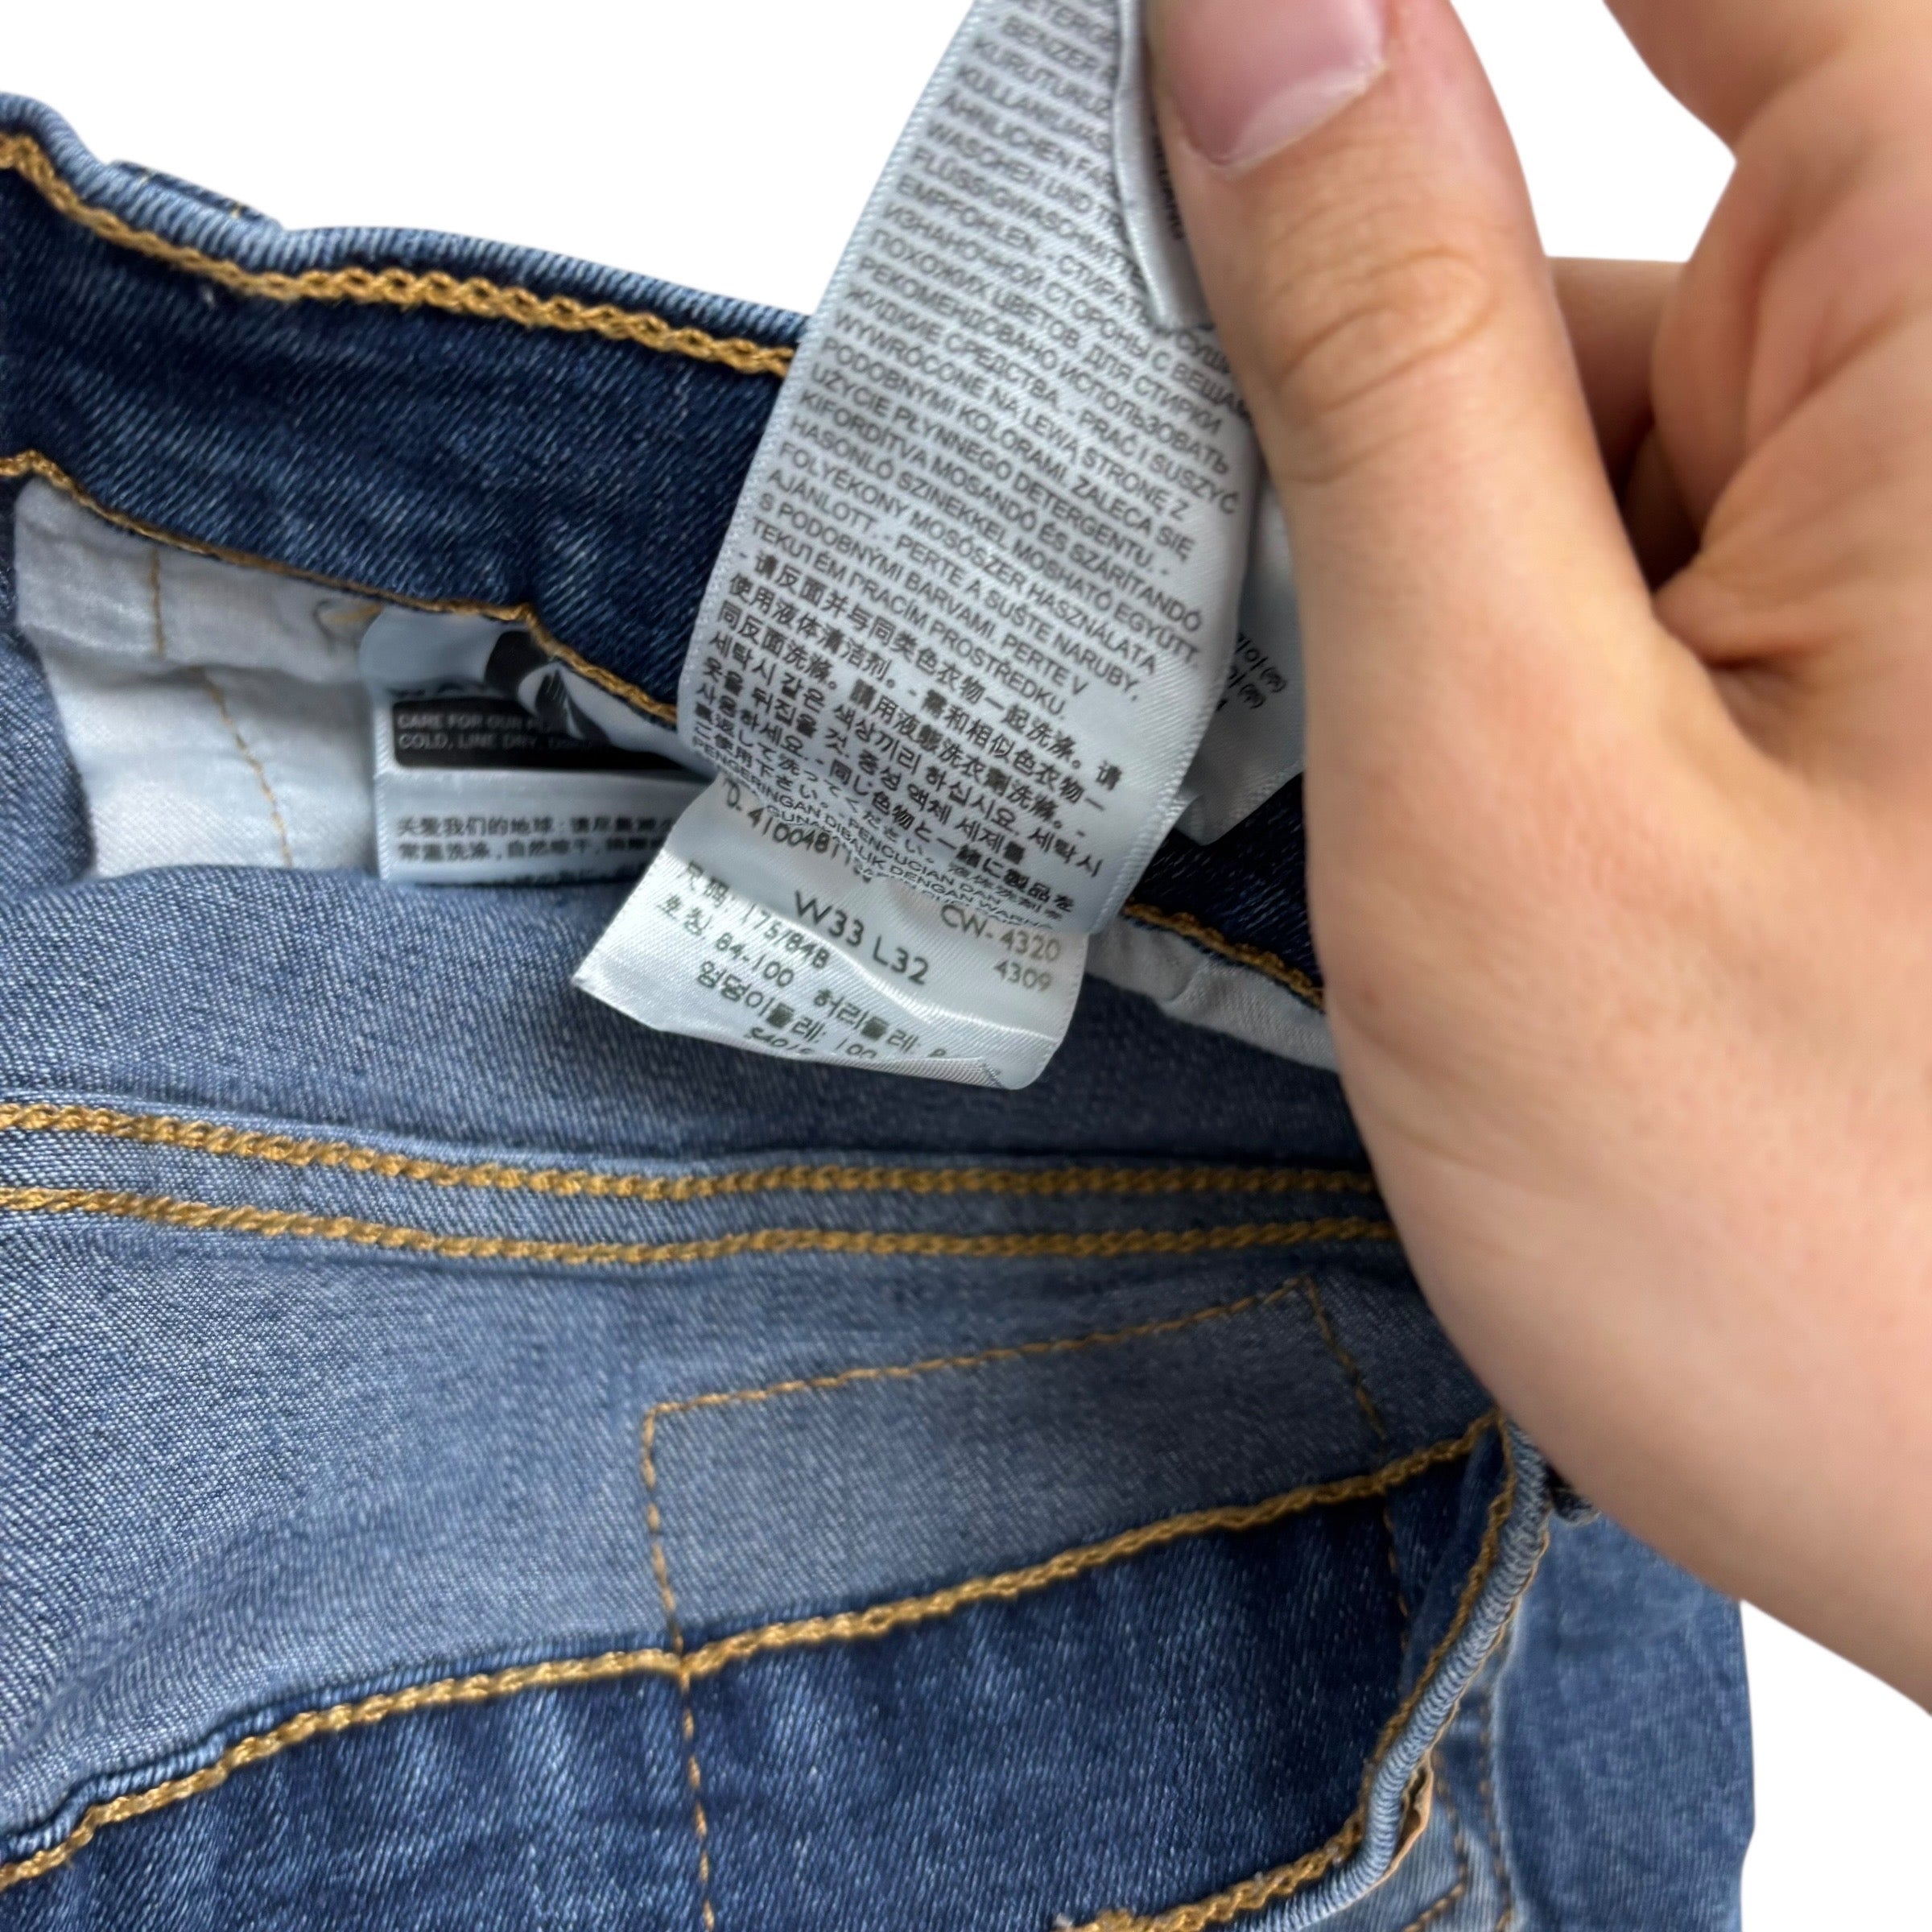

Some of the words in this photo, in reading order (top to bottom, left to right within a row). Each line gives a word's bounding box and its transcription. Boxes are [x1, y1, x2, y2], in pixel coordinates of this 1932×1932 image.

[927, 120, 1042, 188] WASCHEN
[1045, 179, 1092, 213] UND
[857, 255, 1057, 369] РЕКОМЕНДОВАНО
[1059, 361, 1228, 474] ИСПОЛЬЗОВАТЬ
[869, 229, 992, 298] ПОХОЖИХ
[1083, 344, 1133, 382] ДЛЯ
[1134, 375, 1221, 435] СТИРКИ
[1046, 282, 1150, 360] СТОРОНЫ
[821, 336, 956, 413] PODOBNYMI
[1071, 476, 1151, 535] ZALECA
[1157, 526, 1194, 562] SIĘ
[834, 309, 986, 398] WYWRÓCONE
[989, 387, 1017, 415] NA
[1022, 407, 1079, 463] LEWĄ
[1083, 448, 1169, 514] STRONĘ
[1170, 499, 1189, 521] Z
[894, 407, 1012, 480] PŁYNNEGO
[1078, 409, 1136, 456] PRAĆ
[1150, 453, 1238, 514] SUSZYĆ
[790, 415, 894, 481] HASONLÓ
[1012, 539, 1112, 611] MOSHATÓ
[931, 456, 1037, 532] MOSANDÓ
[1038, 522, 1067, 551] ÉS
[759, 493, 774, 511] S
[778, 502, 903, 580] PODOBNÝMI
[1001, 633, 1069, 686] PERTE
[1072, 676, 1088, 696] V
[778, 441, 909, 518] FOLYÉKONY
[909, 510, 1026, 592] MOSÓSZER
[1027, 584, 1155, 675] HASZNÁLATA
[895, 534, 964, 587] PERTE
[965, 580, 980, 599] A
[985, 589, 1052, 642] SUŠTE
[708, 631, 776, 686] 세탁시
[833, 704, 921, 774] 색상끼리
[715, 932, 795, 988] 84-100
[795, 890, 865, 948] W33
[872, 935, 929, 986] L32
[993, 960, 1052, 991] 4309
[1000, 930, 1062, 962] 4320
